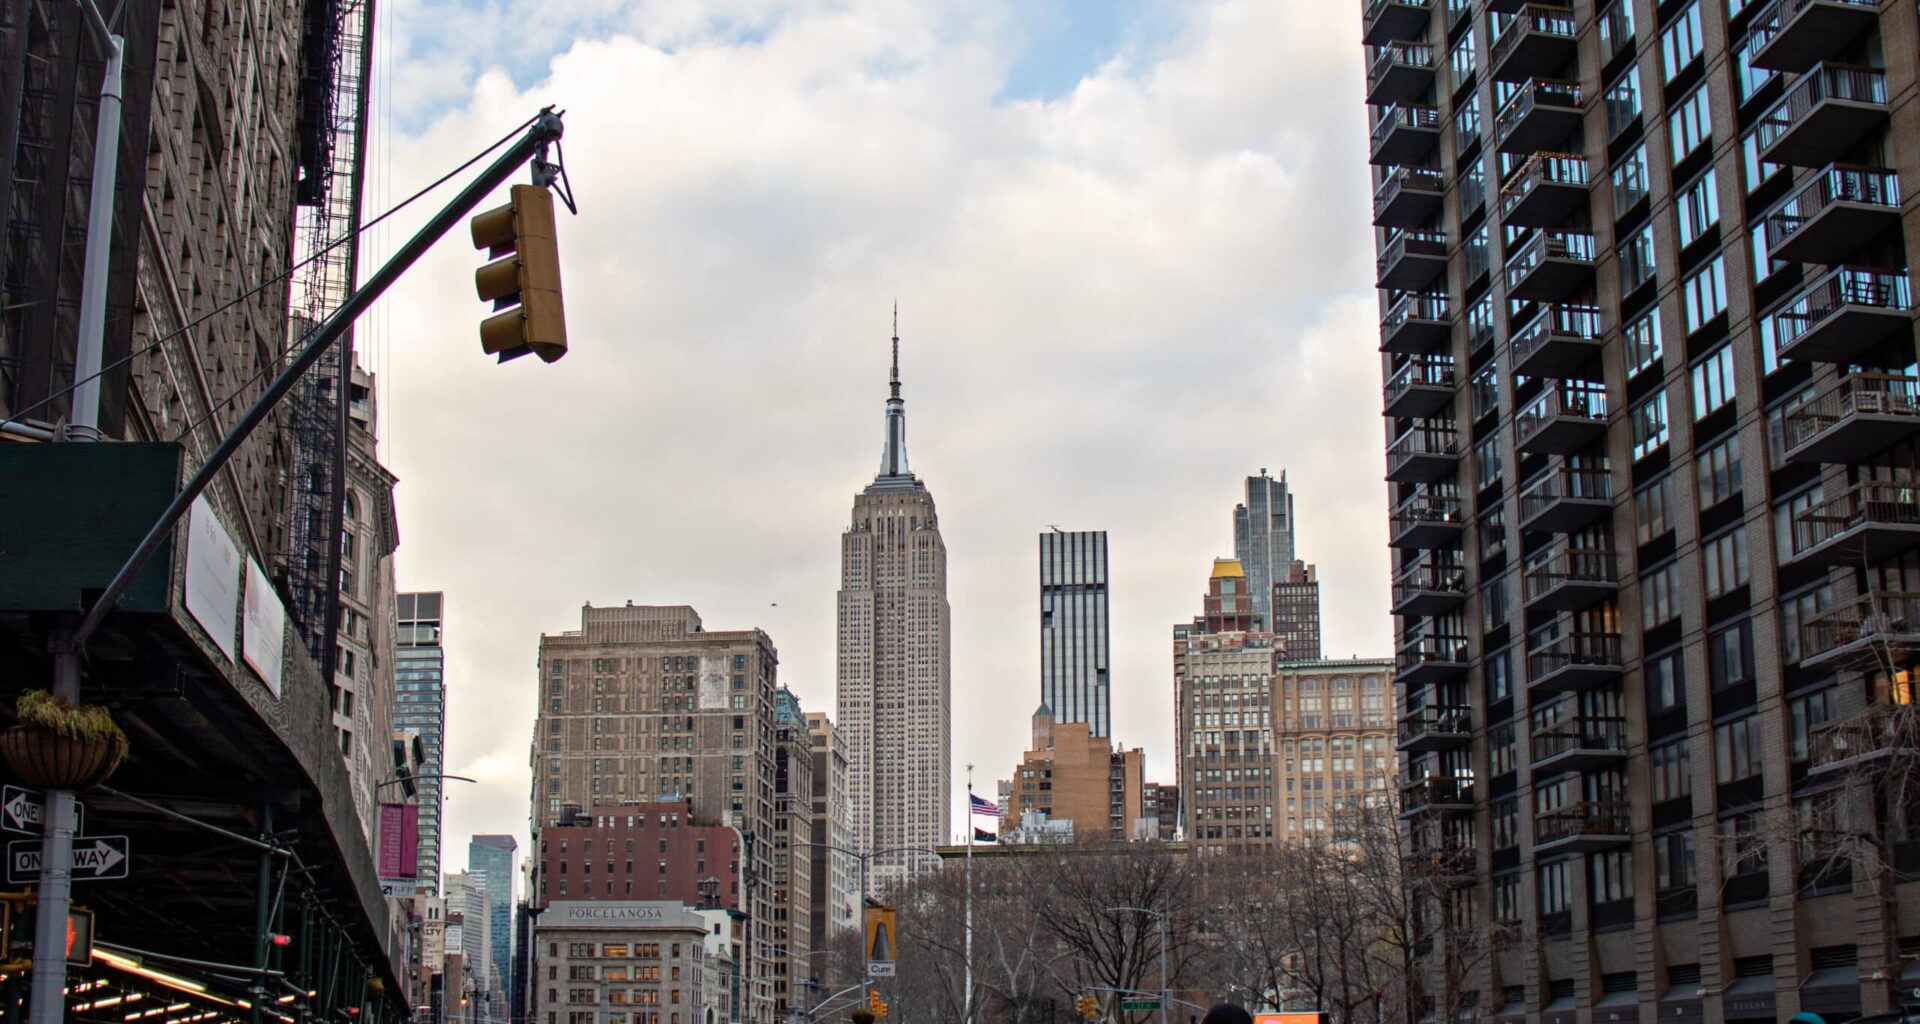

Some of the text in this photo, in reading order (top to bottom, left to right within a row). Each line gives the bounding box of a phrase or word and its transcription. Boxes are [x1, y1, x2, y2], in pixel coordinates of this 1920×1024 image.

[14, 802, 37, 821] ONE
[20, 849, 110, 869] ON WAY
[569, 908, 662, 919] PORCELANOSA
[871, 965, 891, 973] Cure
